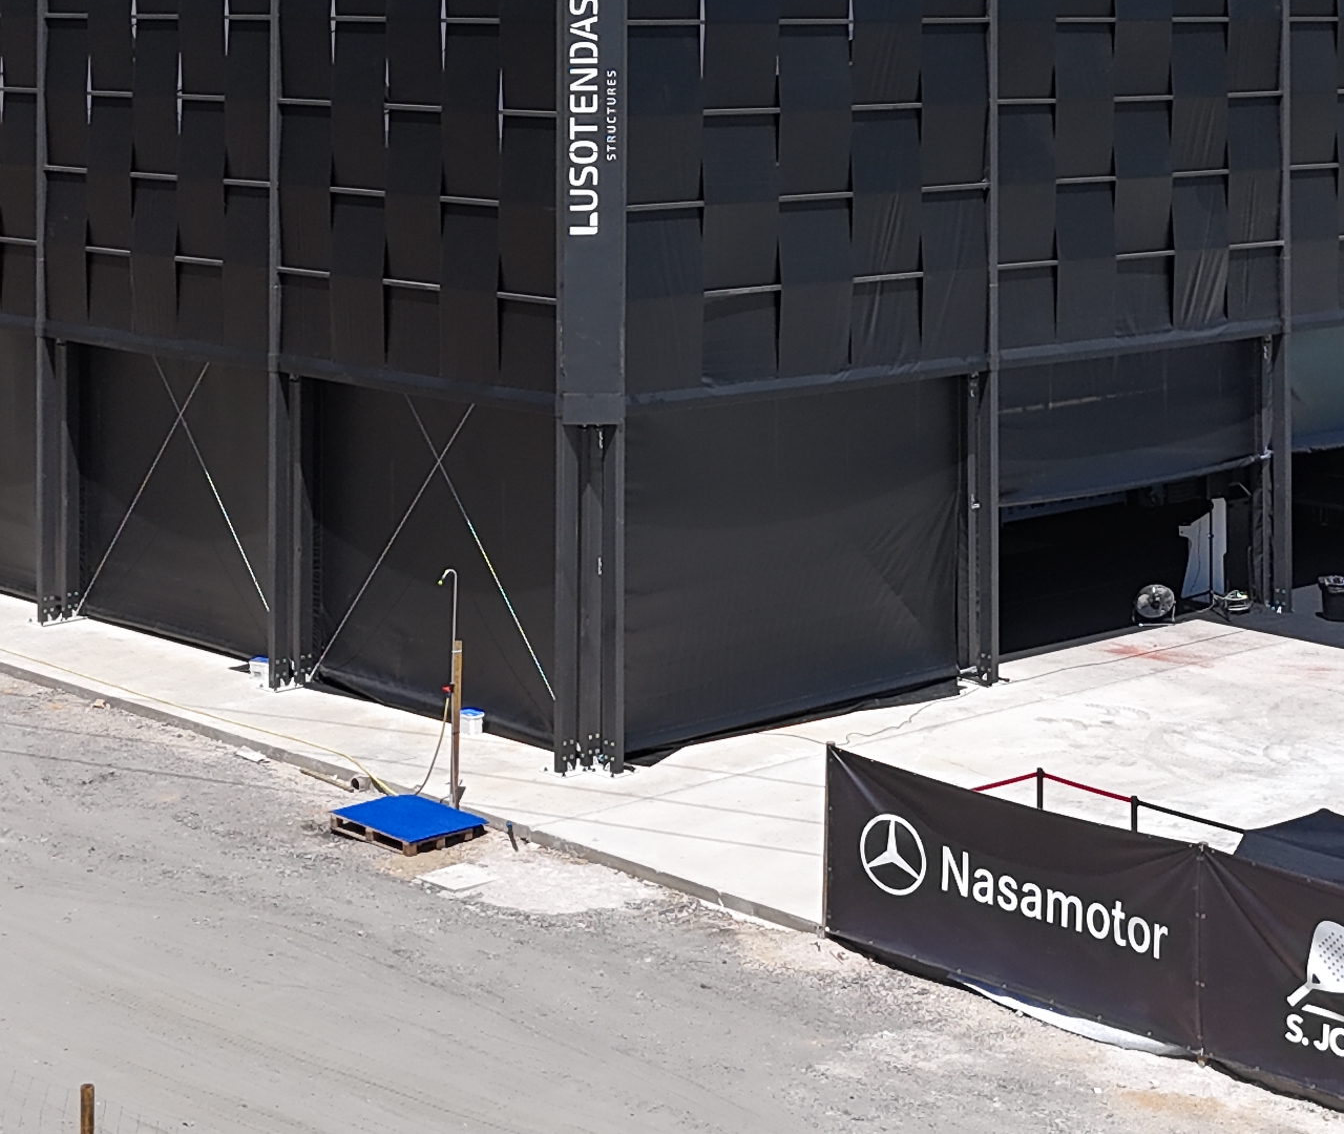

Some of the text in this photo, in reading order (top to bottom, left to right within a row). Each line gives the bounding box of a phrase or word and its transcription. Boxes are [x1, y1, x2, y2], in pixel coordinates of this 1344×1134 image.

[606, 70, 617, 161] STRUCTURES
[941, 845, 1169, 960] Nasamotor
[1285, 1014, 1309, 1046] S.
